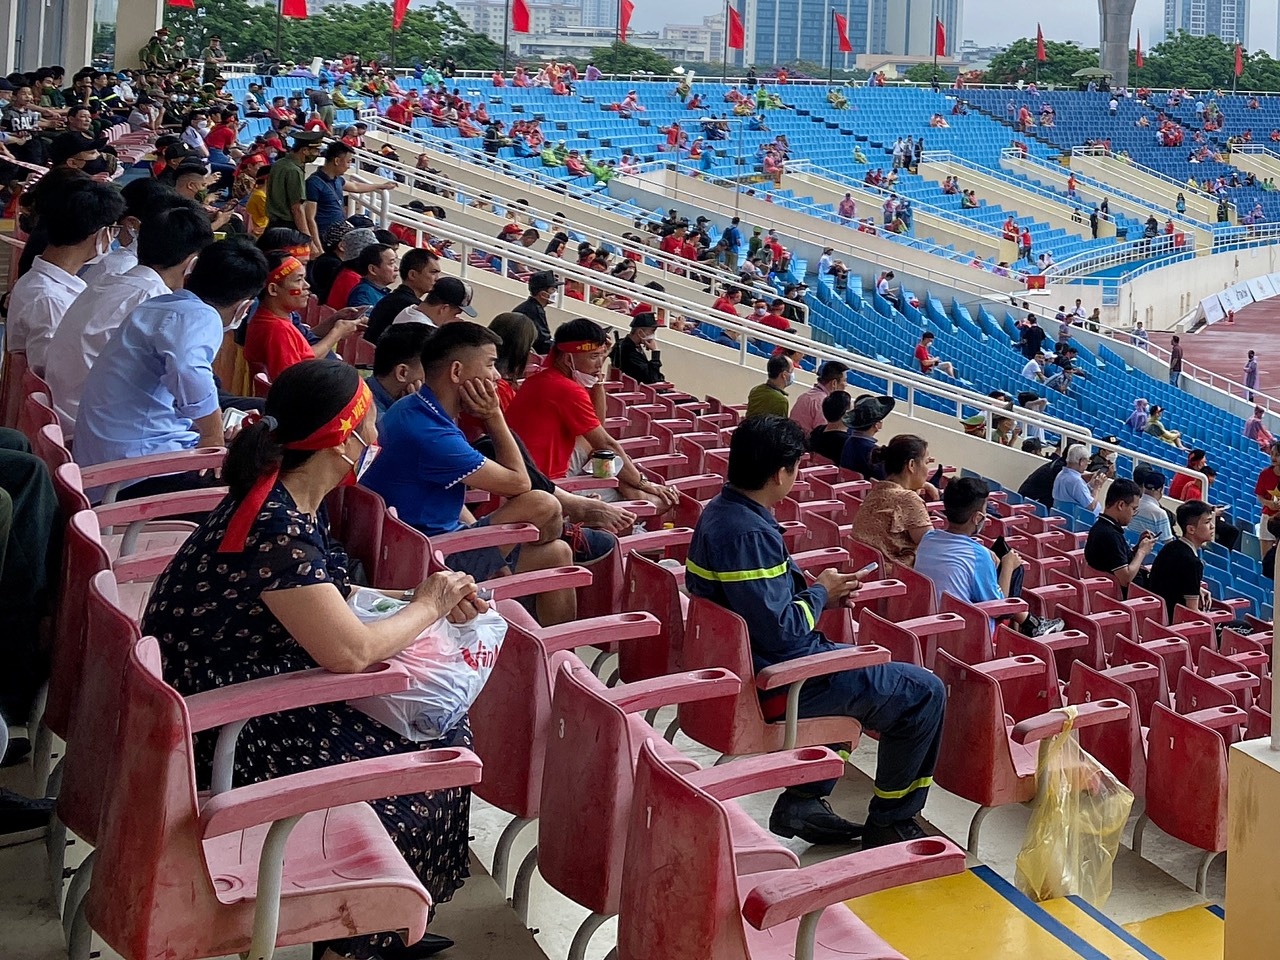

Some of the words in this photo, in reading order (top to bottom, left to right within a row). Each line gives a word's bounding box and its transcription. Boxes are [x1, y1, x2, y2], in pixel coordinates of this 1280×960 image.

[1190, 696, 1197, 707] 5
[557, 718, 566, 740] 3
[1168, 736, 1175, 750] 1
